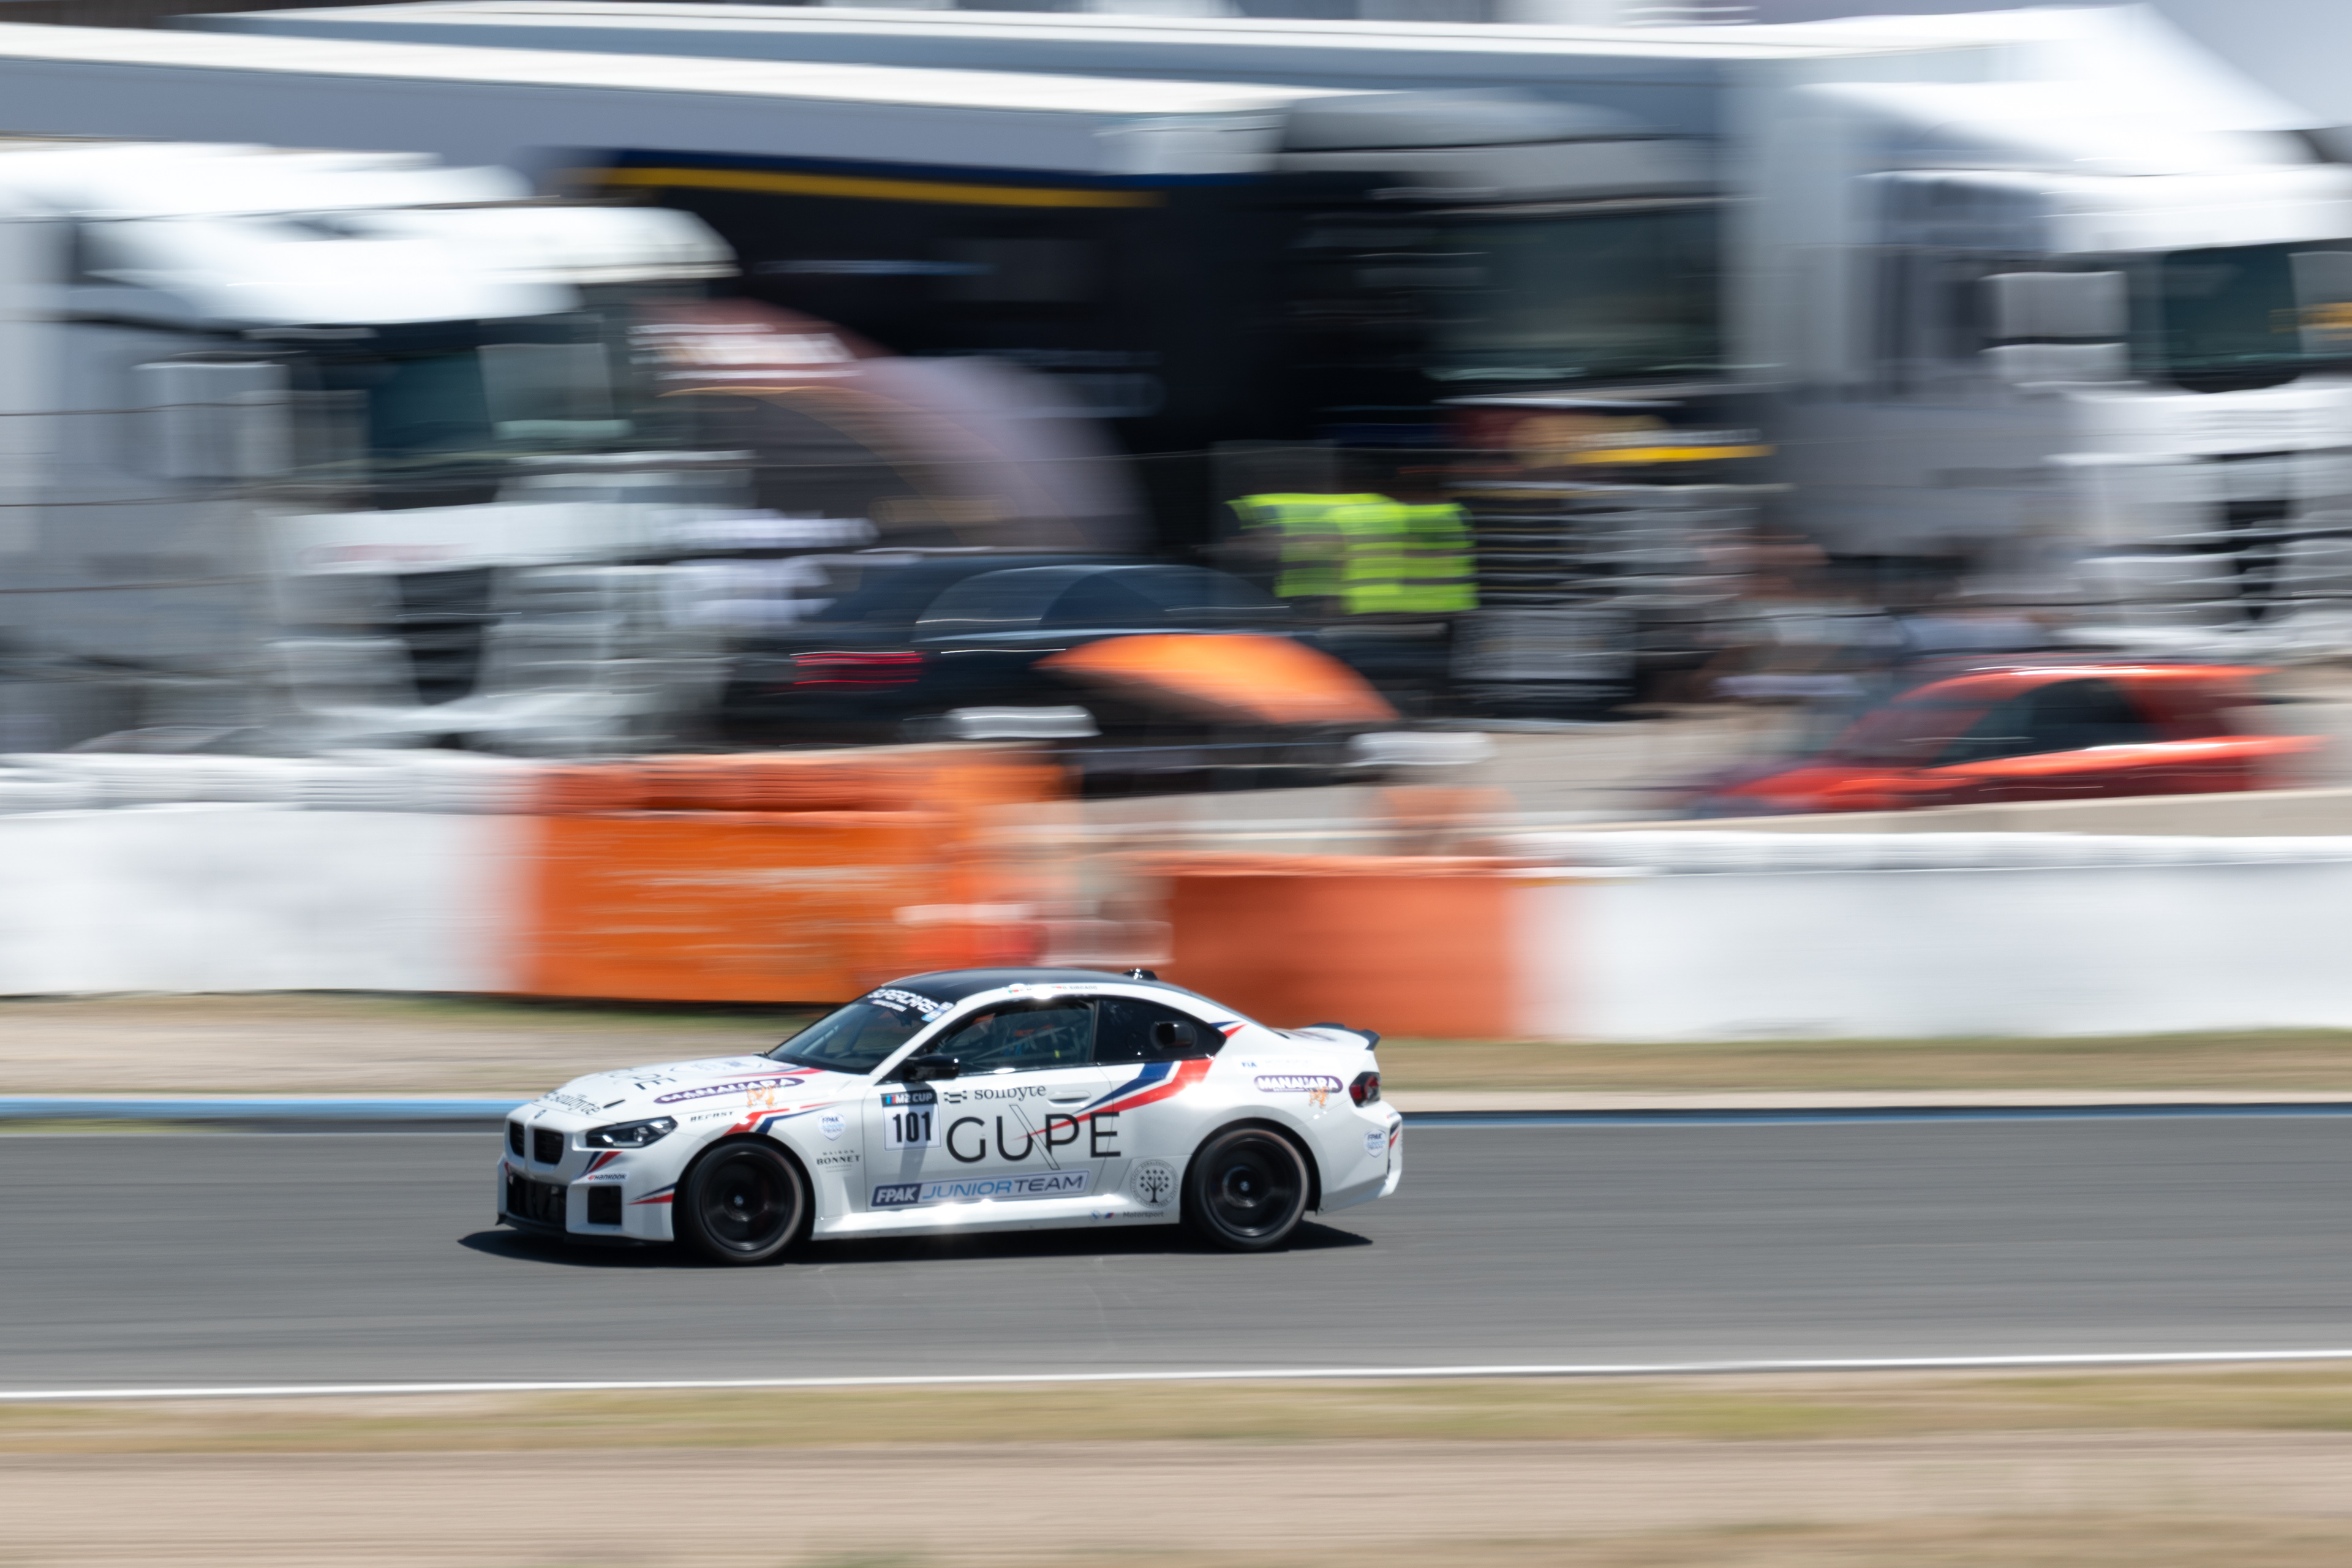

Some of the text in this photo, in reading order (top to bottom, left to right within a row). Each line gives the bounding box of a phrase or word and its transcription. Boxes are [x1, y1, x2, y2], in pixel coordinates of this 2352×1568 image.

[867, 989, 940, 1014] SUPERCARS
[913, 1091, 933, 1102] CUP
[892, 1111, 932, 1143] 101
[946, 1111, 1121, 1164] GUPE
[816, 1155, 861, 1165] BONNET
[875, 1187, 918, 1204] FPAK
